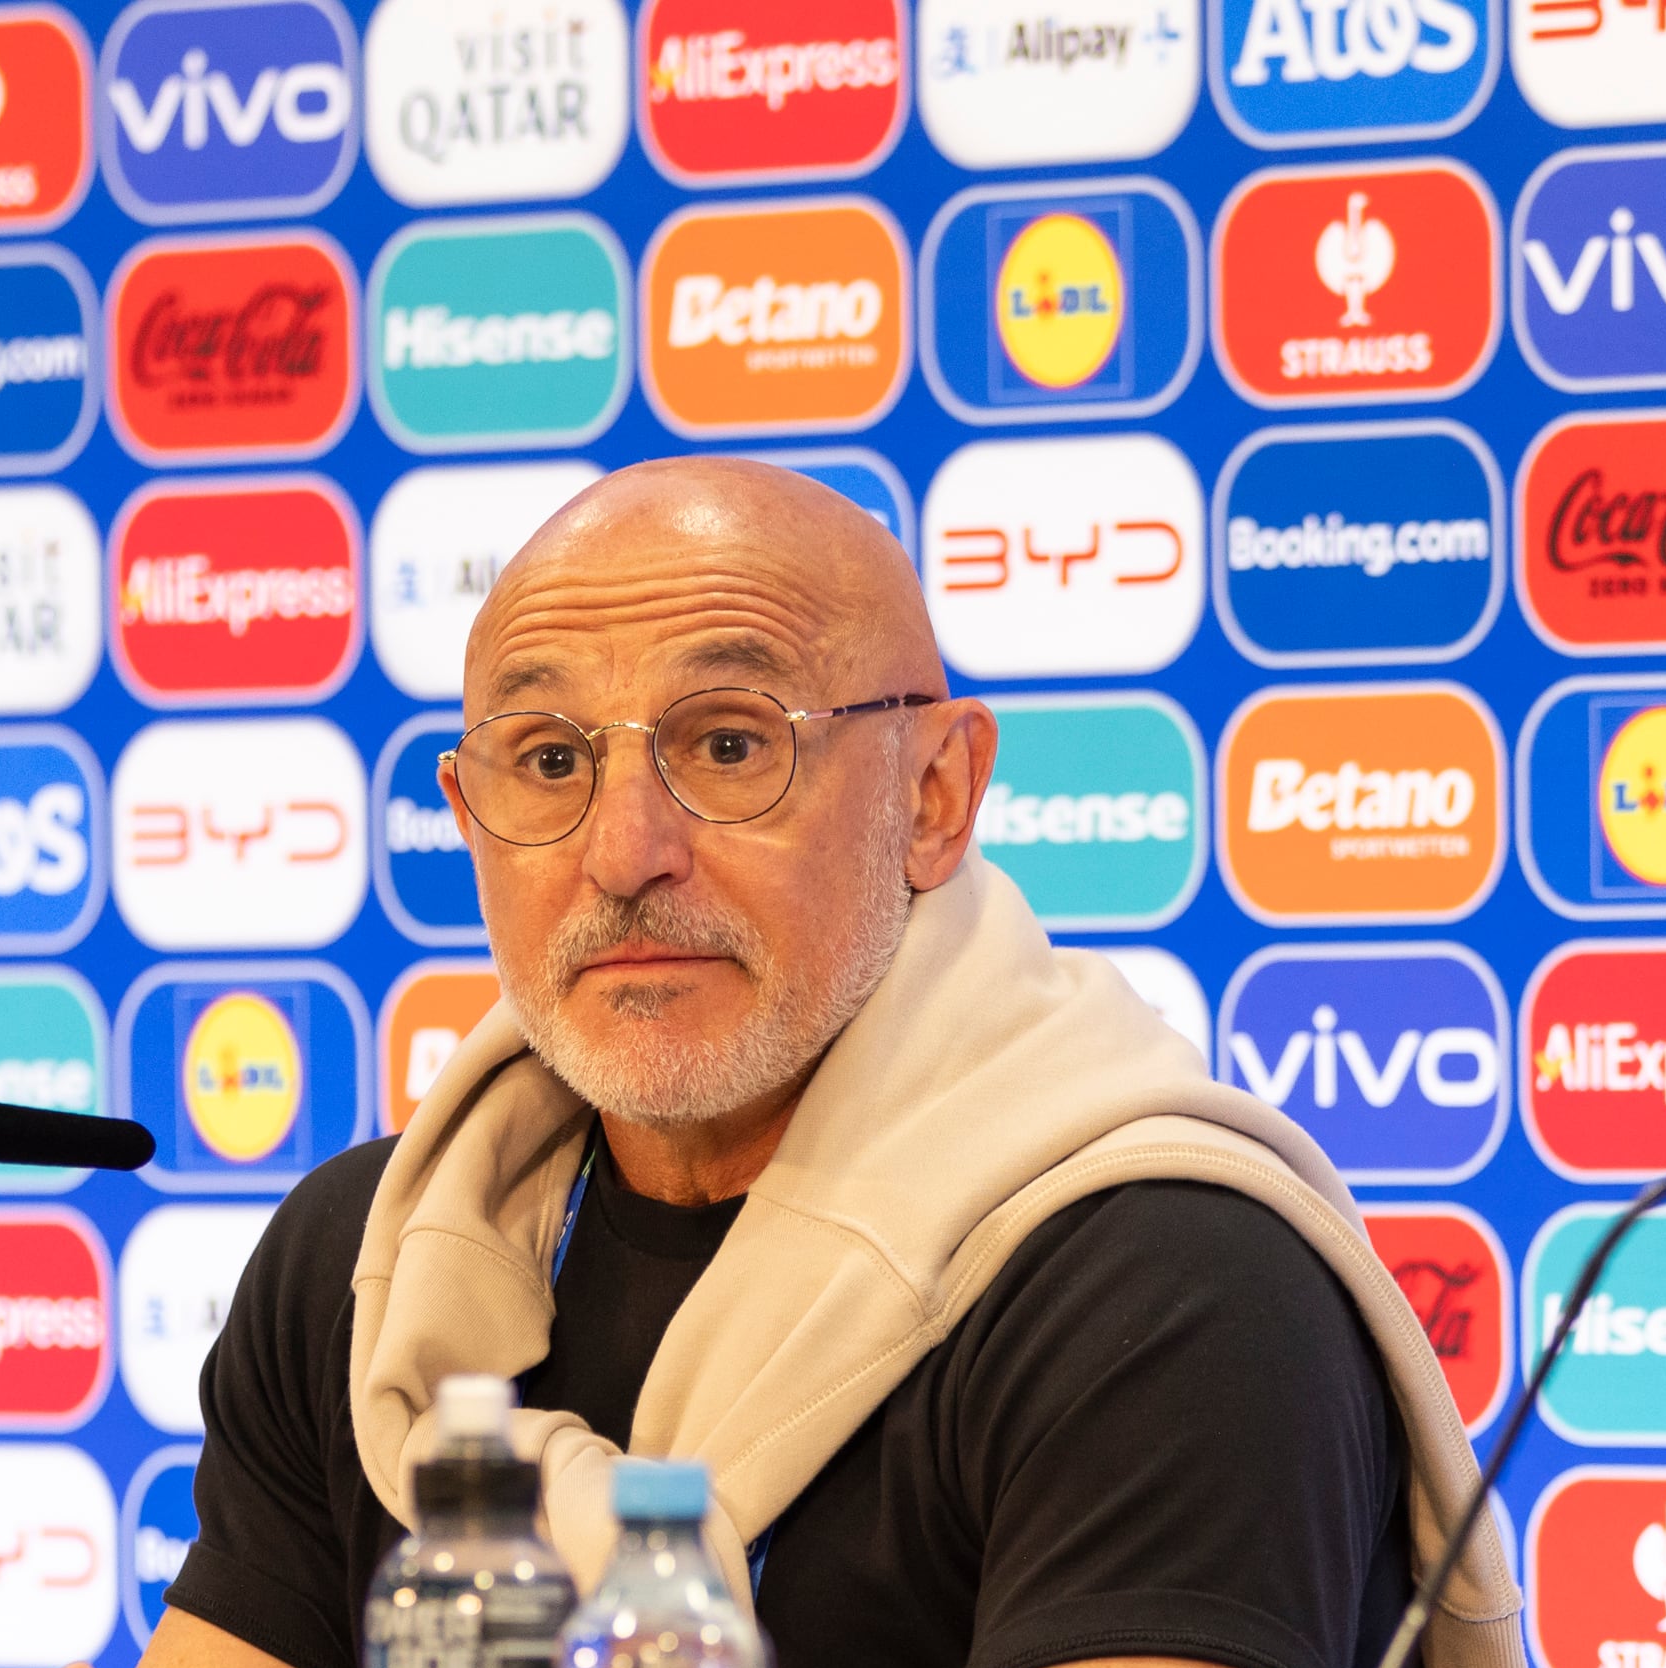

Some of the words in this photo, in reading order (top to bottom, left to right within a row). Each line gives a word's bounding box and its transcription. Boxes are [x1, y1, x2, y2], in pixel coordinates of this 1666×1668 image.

[454, 8, 594, 72] visit
[649, 29, 899, 110] AliExpress
[108, 48, 353, 154] vivo
[398, 82, 595, 161] QATAR
[384, 303, 616, 370] Hisense
[668, 274, 883, 350] Betano
[1281, 334, 1432, 378] STRAUSS
[943, 521, 1184, 593] BYD
[1228, 513, 1489, 578] Booking.com
[123, 552, 353, 636] AliExpress
[1247, 757, 1474, 833] Betano
[132, 800, 349, 867] BYD
[1229, 1005, 1501, 1108] vivo
